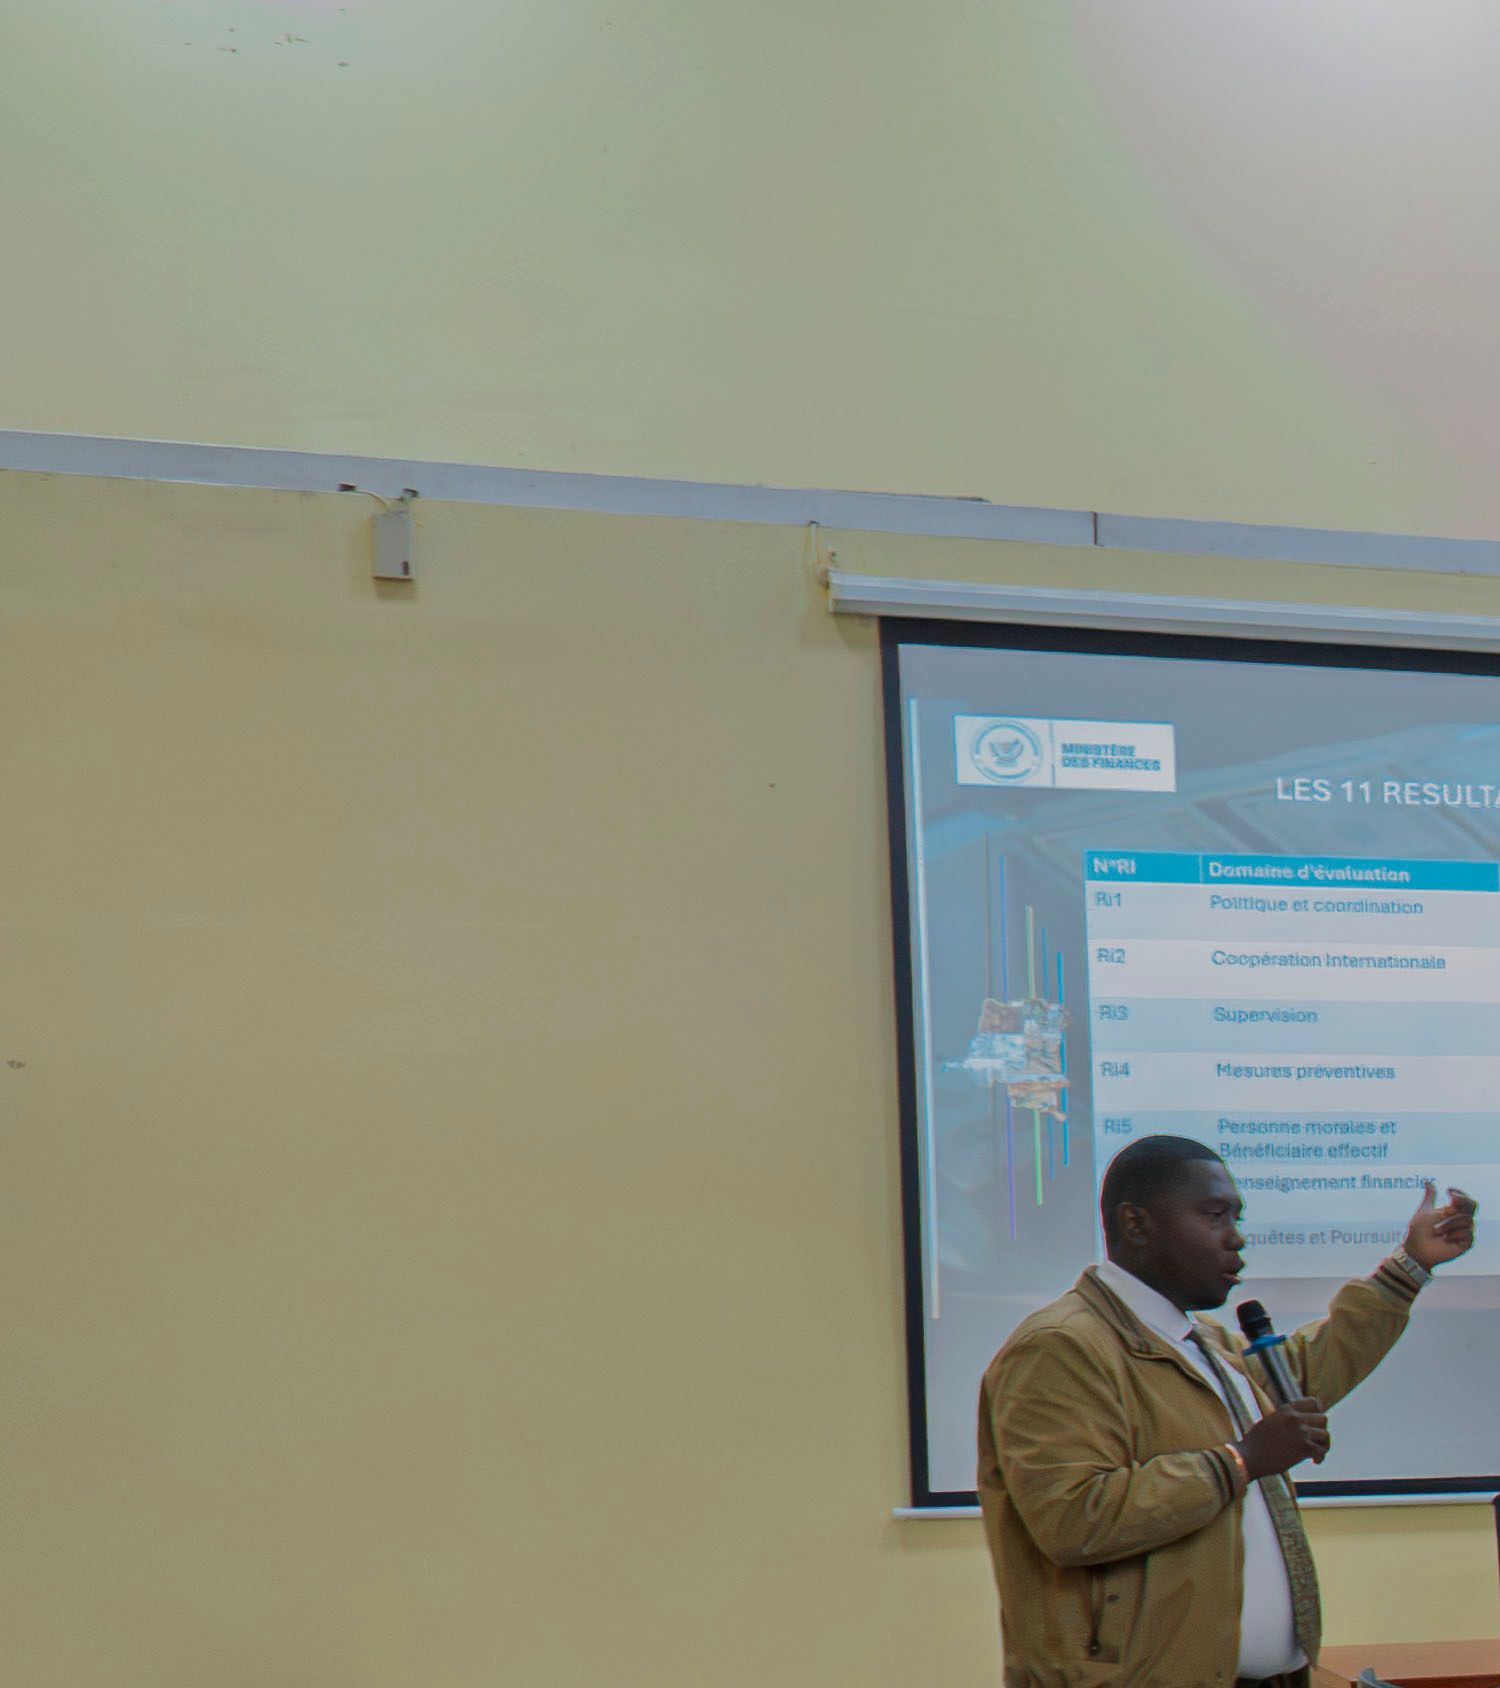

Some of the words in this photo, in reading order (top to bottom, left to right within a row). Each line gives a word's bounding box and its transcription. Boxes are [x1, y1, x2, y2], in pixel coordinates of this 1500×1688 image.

[1061, 742, 1136, 757] MINISTÈRE
[1061, 757, 1091, 769] DES
[1093, 758, 1162, 772] FINANCES
[1276, 777, 1331, 802] LES
[1340, 780, 1372, 804] 11
[1209, 862, 1293, 879] Domaine
[1298, 865, 1410, 882] d'évaluation
[1210, 895, 1288, 914] Politique
[1293, 899, 1309, 912] et
[1314, 900, 1424, 915] coordination
[1211, 950, 1322, 968] Coopération
[1214, 1007, 1318, 1024] Supervision
[1217, 1063, 1292, 1079] Mesures
[1297, 1063, 1396, 1080] préventives
[1105, 1119, 1132, 1133] Ri5
[1218, 1118, 1301, 1134] Personne
[1305, 1120, 1376, 1134] morales
[1381, 1121, 1397, 1134] et
[1220, 1142, 1323, 1158] Bénéficiaire
[1328, 1143, 1389, 1158] effectif
[1234, 1174, 1357, 1193] enseignement
[1249, 1229, 1305, 1247] quêtes
[1309, 1231, 1326, 1245] et
[1331, 1229, 1402, 1245] Poursuit
